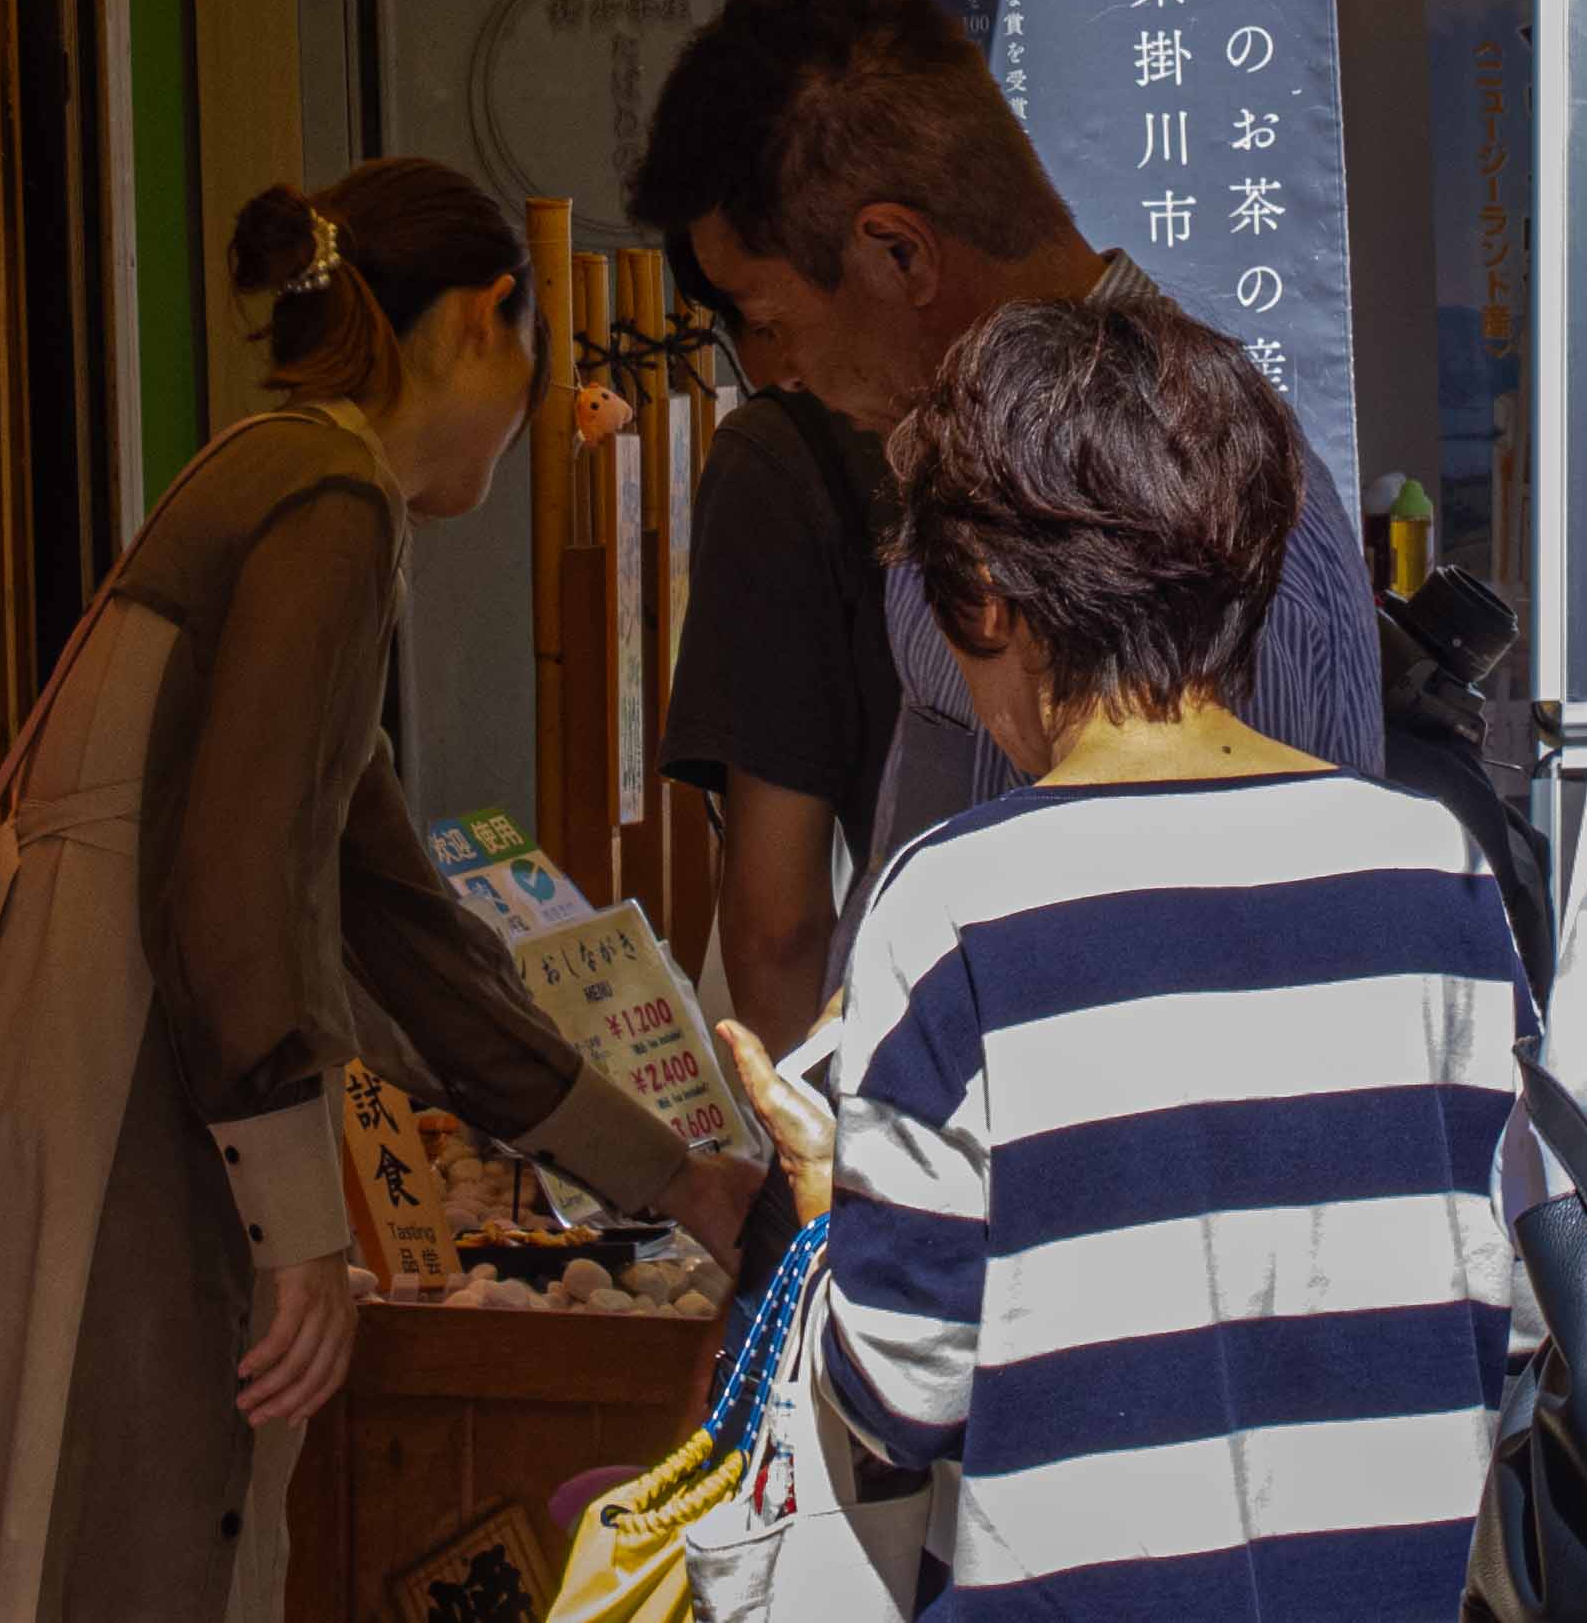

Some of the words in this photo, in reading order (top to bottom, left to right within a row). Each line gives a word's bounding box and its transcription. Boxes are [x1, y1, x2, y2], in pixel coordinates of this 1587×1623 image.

[542, 929, 638, 985] おしながき
[583, 981, 614, 1002] MENU
[345, 1067, 420, 1209] 試食
[387, 1222, 436, 1243] Tasting
